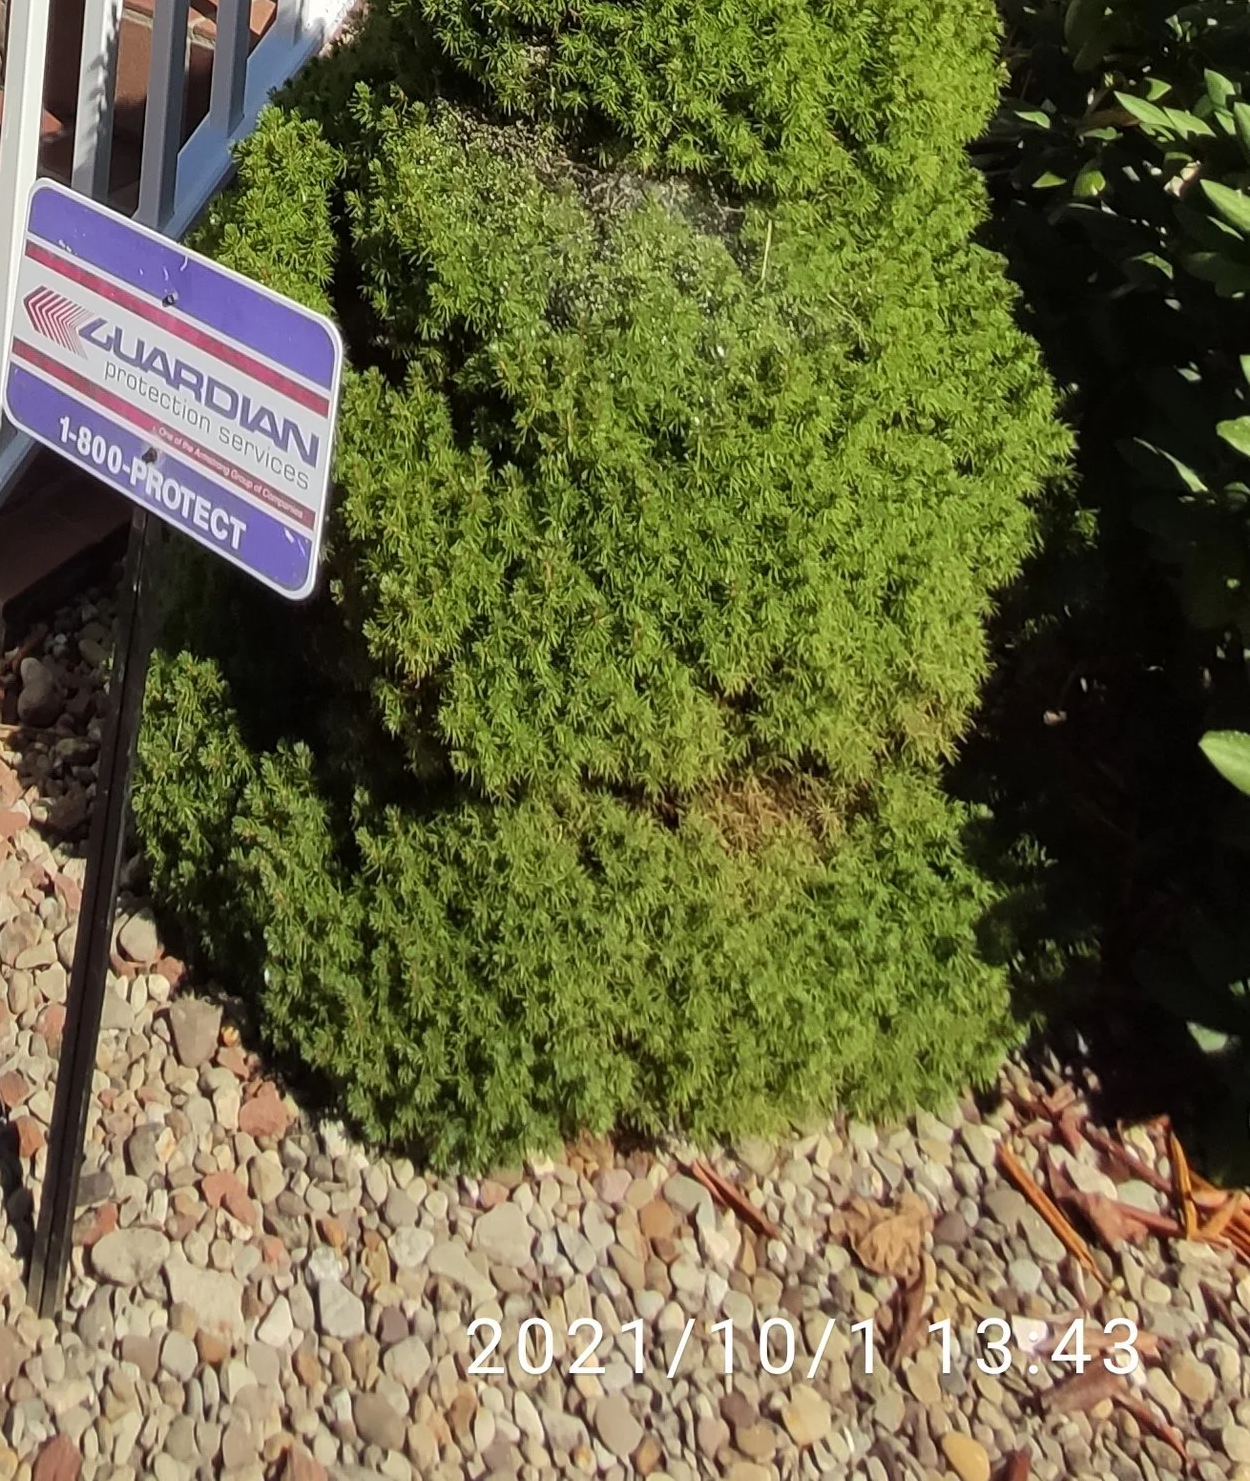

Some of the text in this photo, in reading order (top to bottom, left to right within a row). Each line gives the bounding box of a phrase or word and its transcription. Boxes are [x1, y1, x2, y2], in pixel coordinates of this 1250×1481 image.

[79, 317, 320, 468] GUARDIAN
[104, 360, 310, 490] protection services
[158, 427, 174, 440] One
[173, 435, 183, 445] of
[182, 438, 195, 452] the
[193, 447, 230, 476] Armstrong
[230, 468, 254, 489] Group
[60, 416, 247, 550] 1-800-PROTECT
